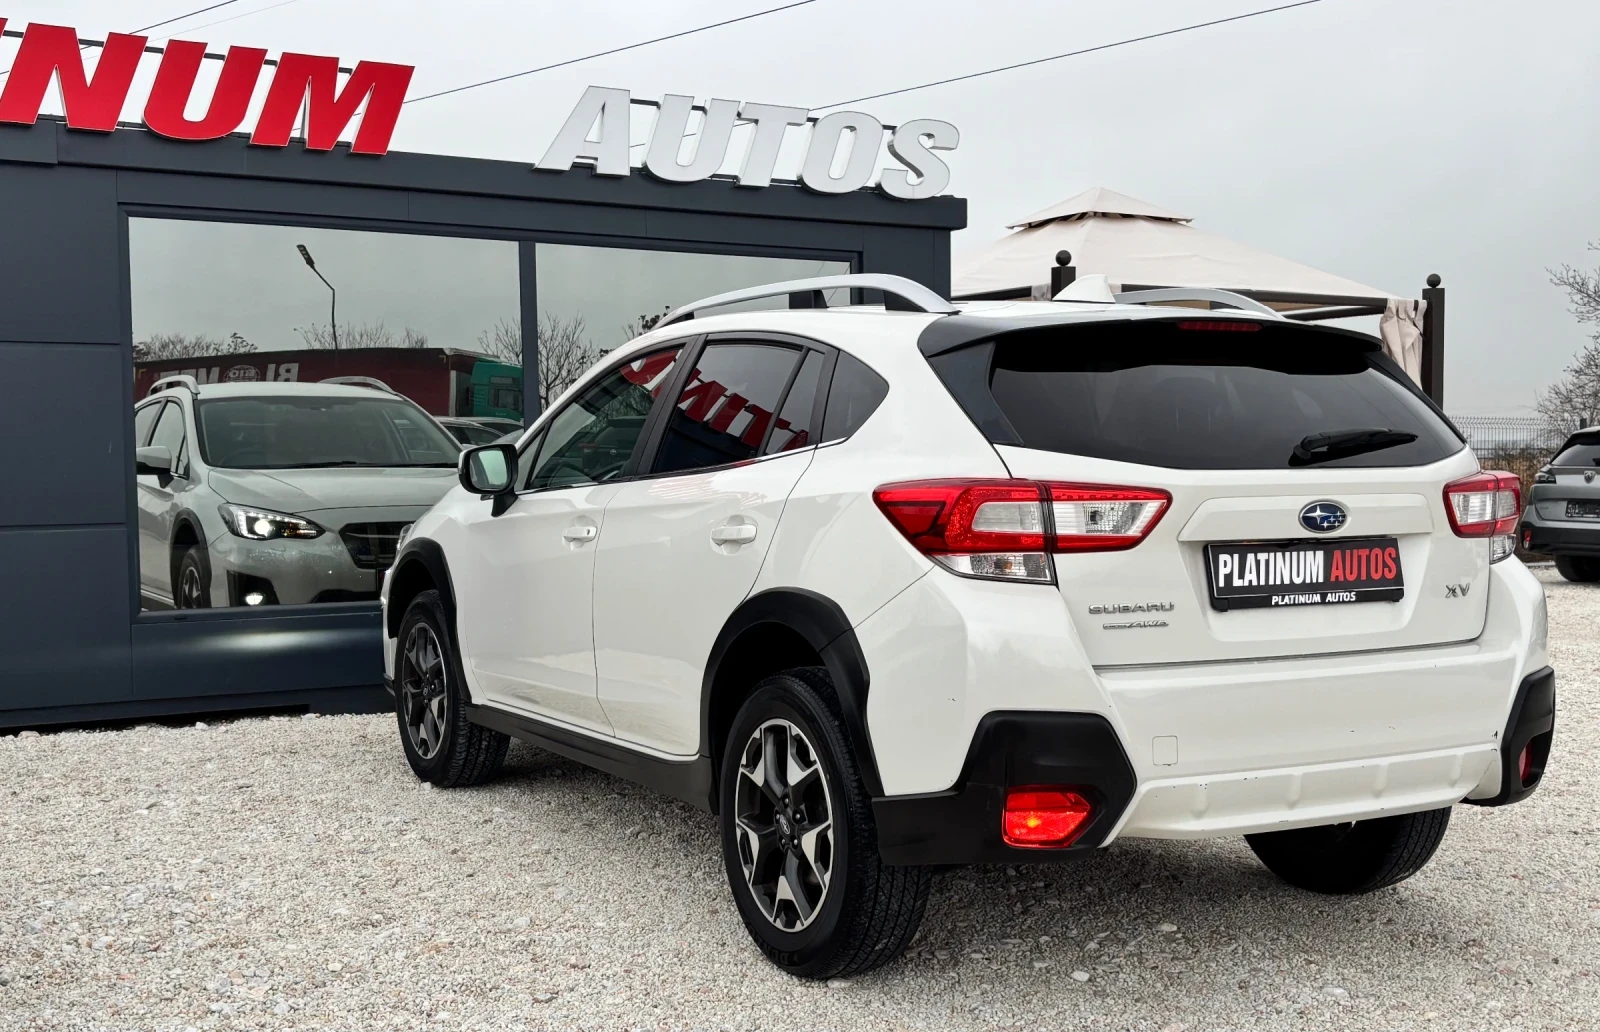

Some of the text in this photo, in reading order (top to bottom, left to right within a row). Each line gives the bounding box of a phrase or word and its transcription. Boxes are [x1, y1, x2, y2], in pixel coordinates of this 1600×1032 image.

[0, 18, 960, 200] NUM AUTOS
[1218, 547, 1397, 588] PLATINUM AUTOS
[1271, 591, 1357, 606] PLATINUM AUTOS
[1444, 582, 1471, 599] XV
[1088, 601, 1176, 615] SUBARU
[1128, 620, 1169, 629] AWD
